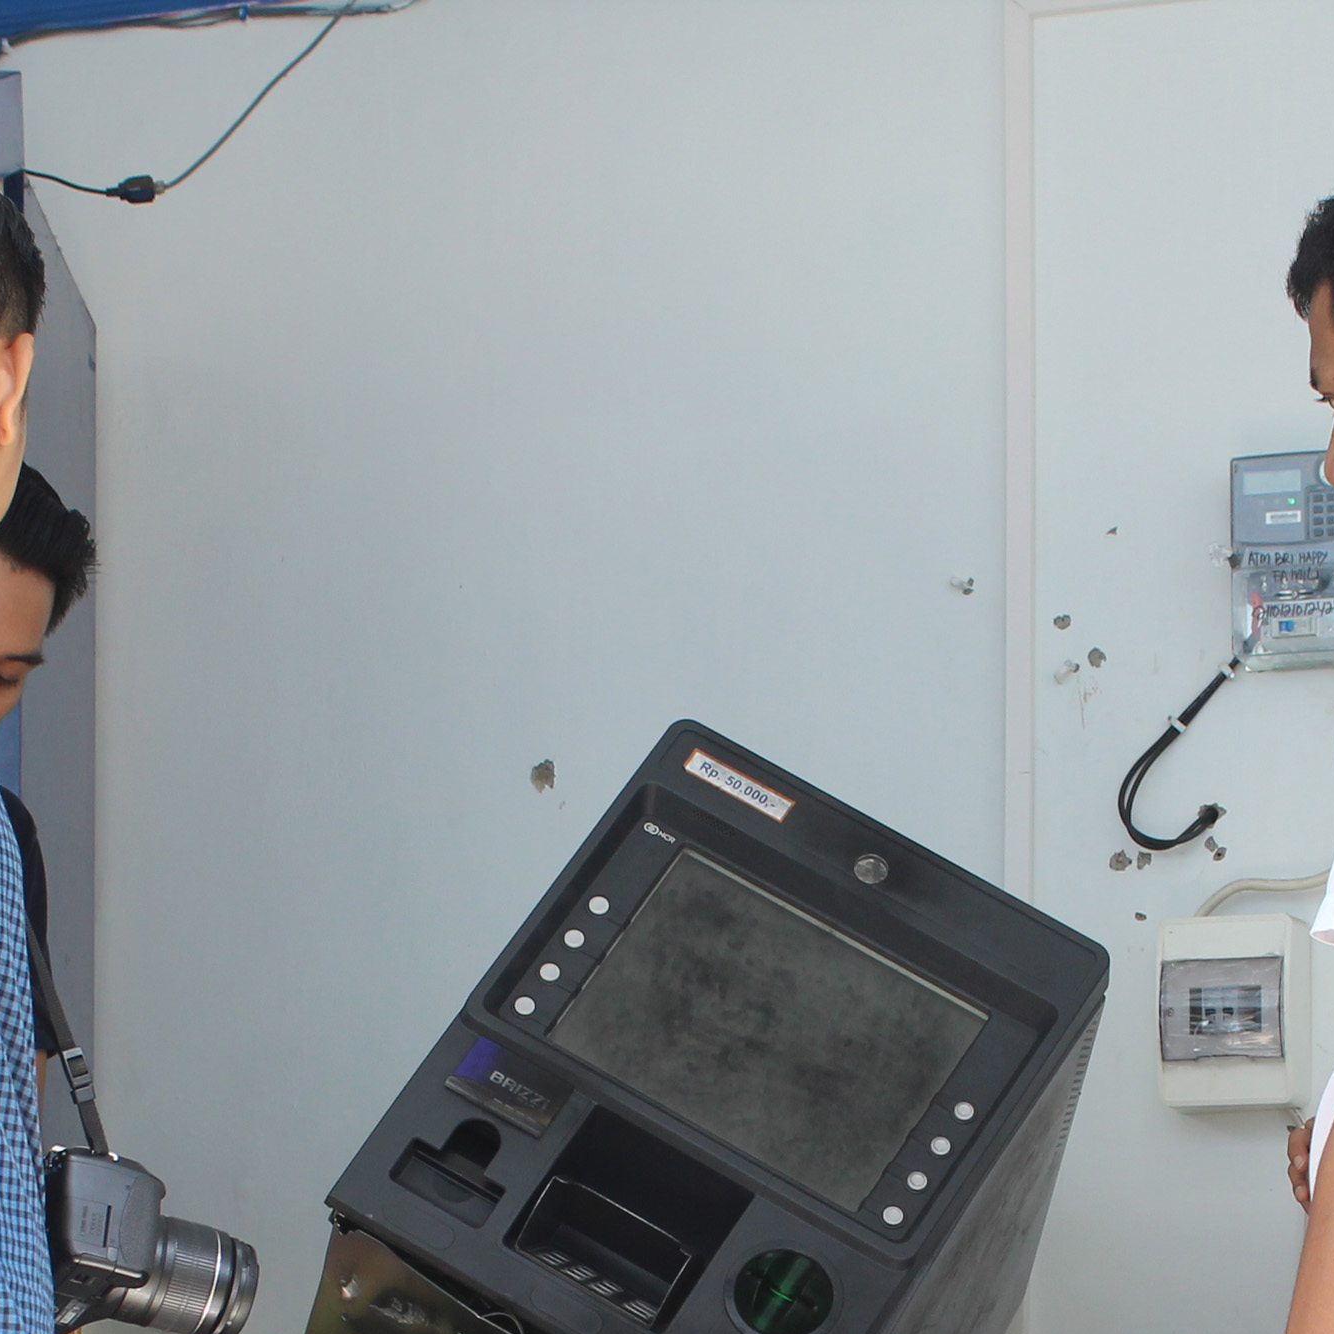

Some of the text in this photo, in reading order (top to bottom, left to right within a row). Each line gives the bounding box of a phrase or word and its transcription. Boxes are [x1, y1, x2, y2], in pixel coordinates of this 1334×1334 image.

[1248, 550, 1328, 566] ATM BRI HAPPY
[699, 761, 776, 808] Rp. 50.000,-
[657, 829, 676, 844] NCR
[490, 1070, 551, 1111] BRIZZI
